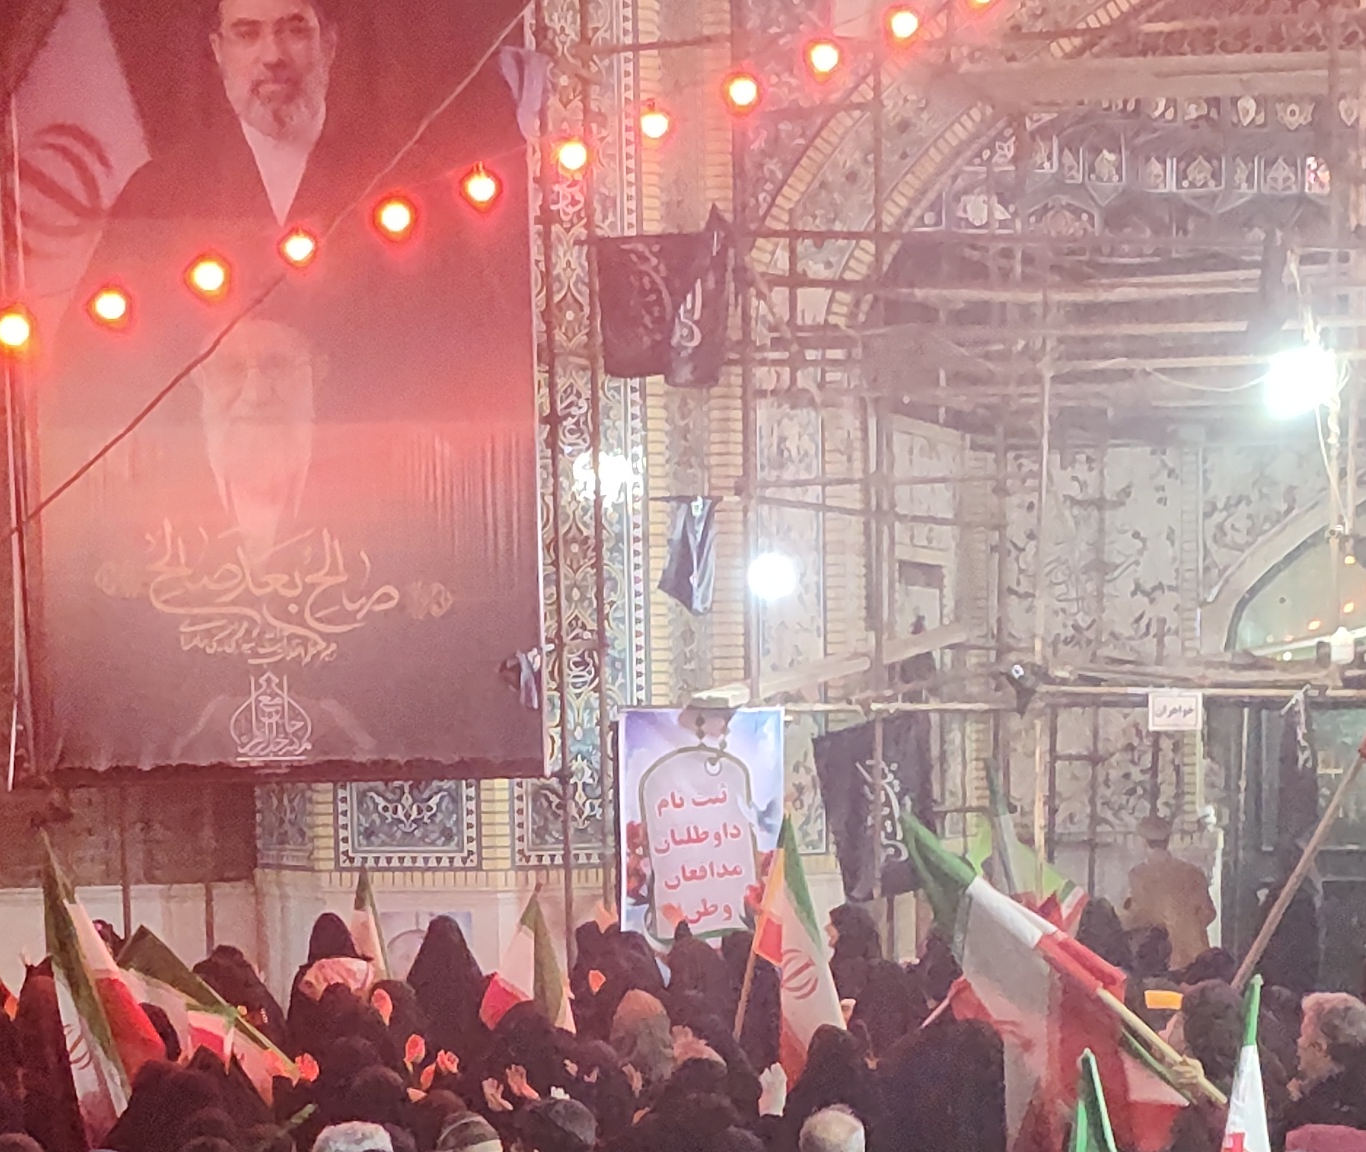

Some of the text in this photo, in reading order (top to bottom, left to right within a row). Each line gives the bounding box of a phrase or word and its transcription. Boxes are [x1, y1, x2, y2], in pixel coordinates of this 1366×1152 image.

[656, 784, 729, 818] ثبت نام
[653, 822, 743, 856] داوطلبان
[664, 862, 743, 891] مدافعان
[687, 899, 734, 925] وطن
